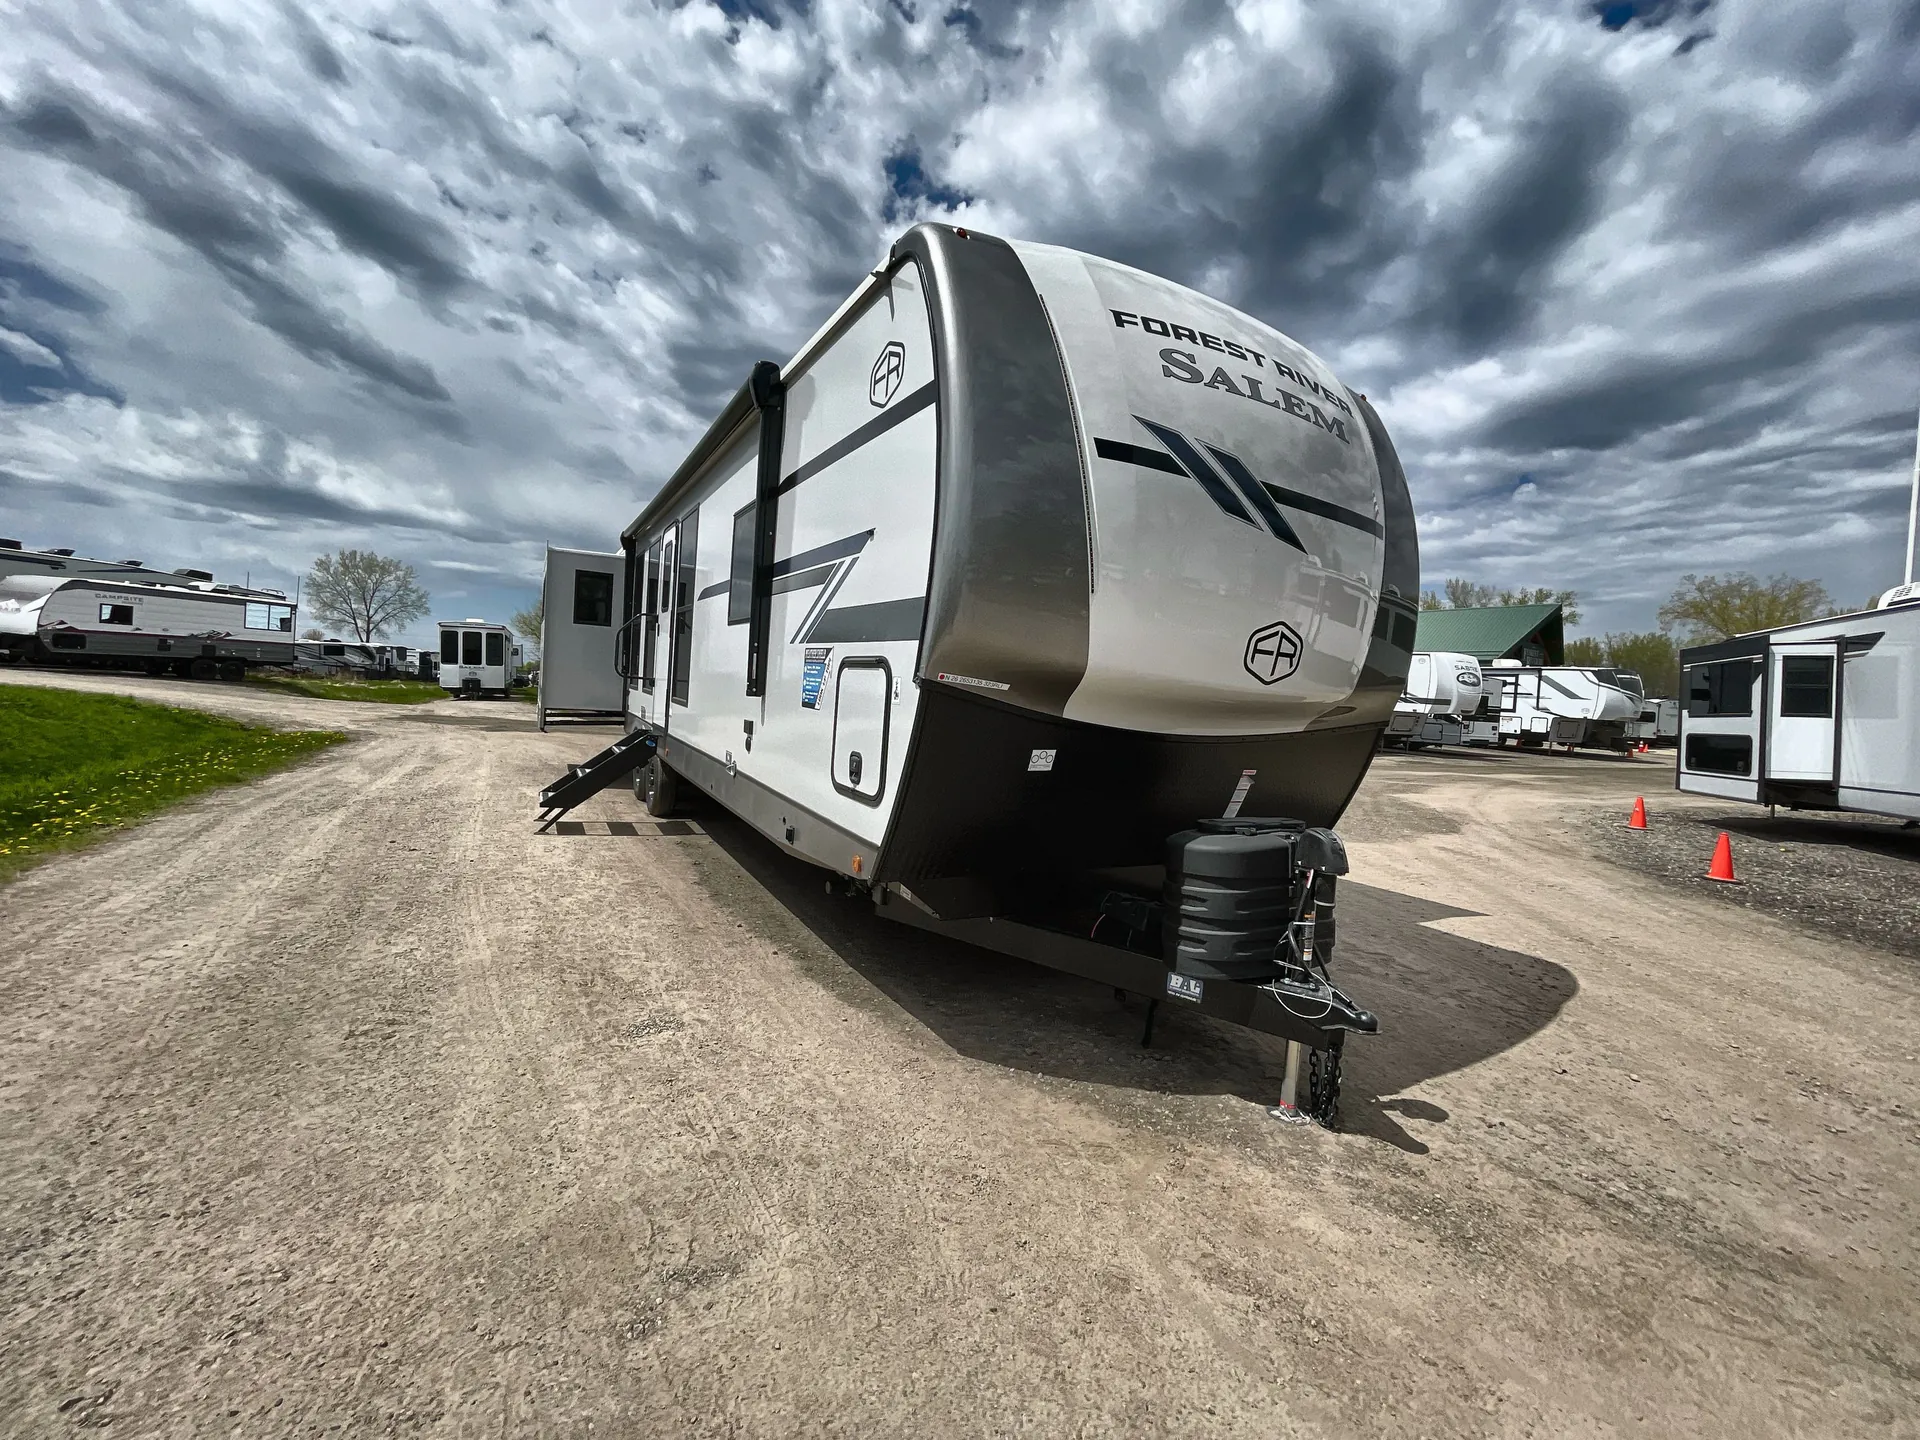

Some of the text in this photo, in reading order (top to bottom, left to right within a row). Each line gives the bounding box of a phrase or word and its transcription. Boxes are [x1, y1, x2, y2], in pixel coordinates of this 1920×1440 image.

[1109, 309, 1354, 419] FOREST RIVER
[1159, 348, 1350, 444] SALEM
[95, 593, 144, 602] CAMPSITE
